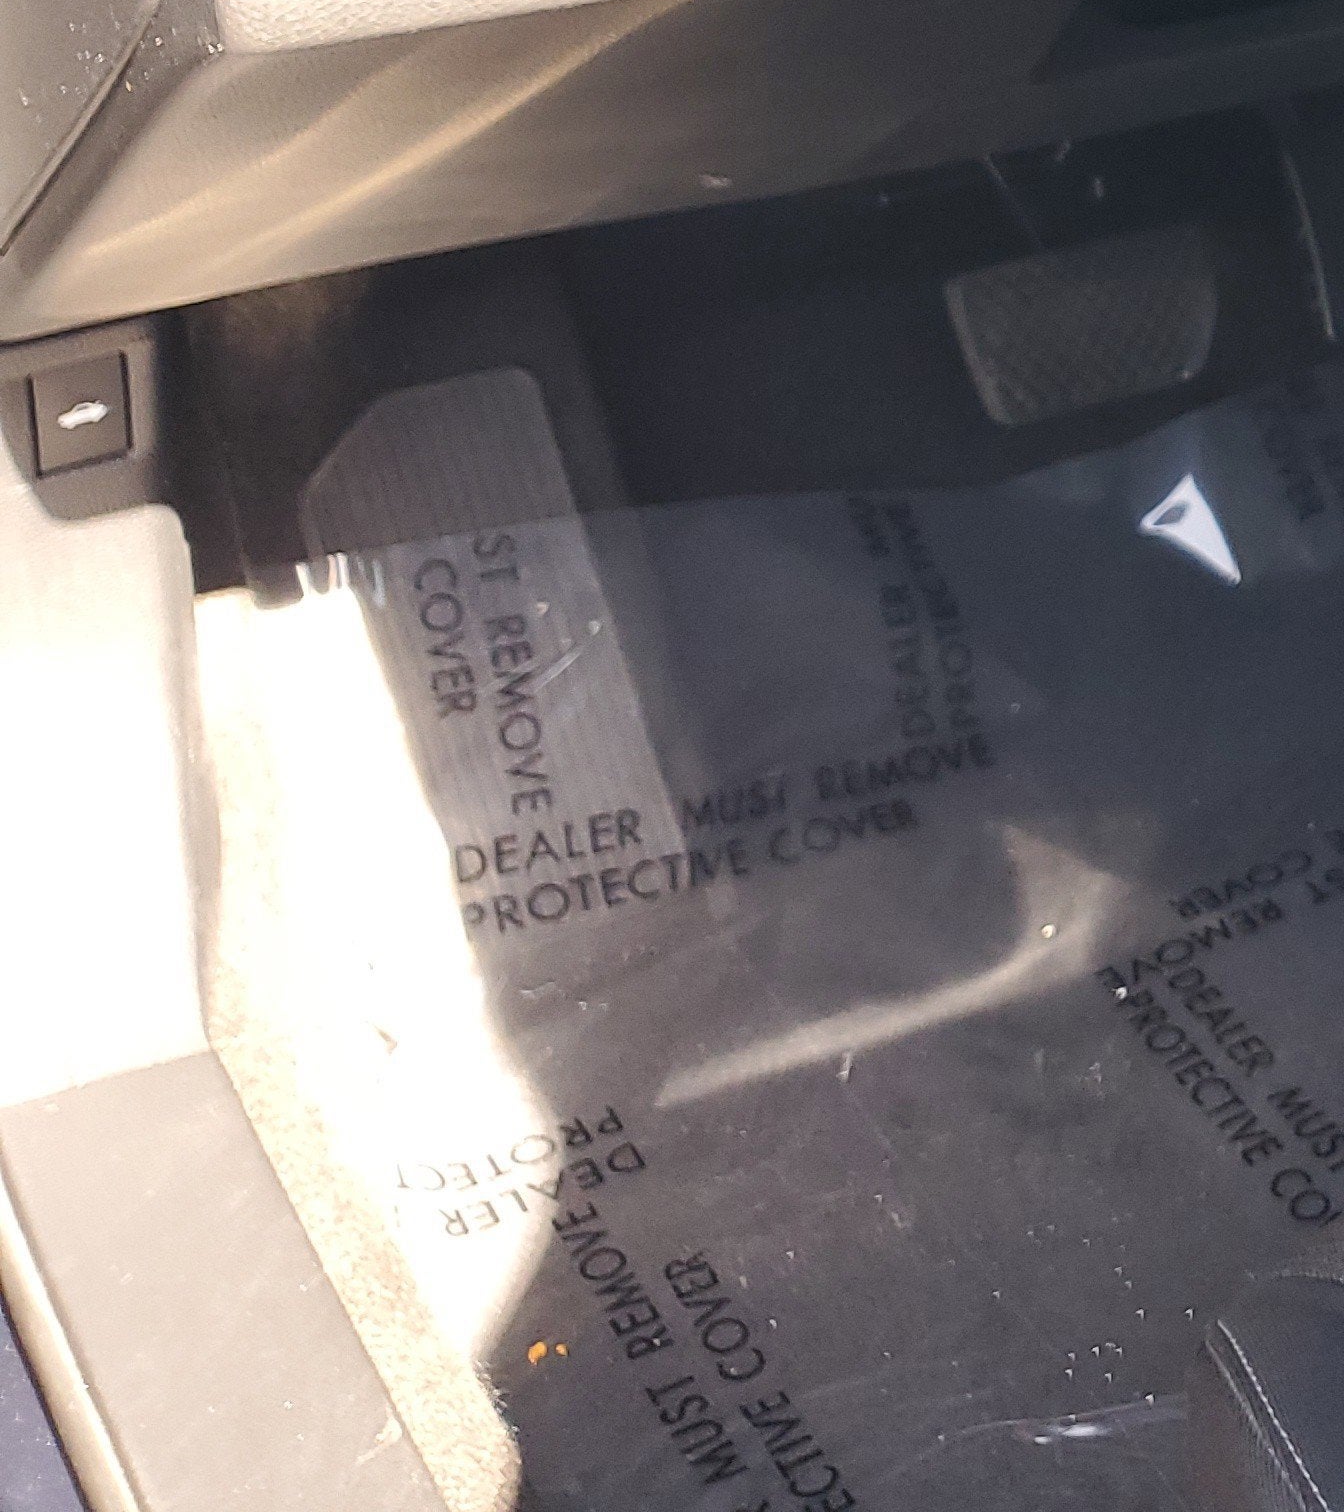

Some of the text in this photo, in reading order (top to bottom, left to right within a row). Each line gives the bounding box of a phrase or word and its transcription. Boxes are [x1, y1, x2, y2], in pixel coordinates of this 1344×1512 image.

[413, 558, 479, 720] COVER
[481, 614, 556, 816] REMOVE
[455, 733, 997, 884] DEALER MUST REMOVE
[463, 799, 920, 933] PROTECTIVE COVER
[1095, 898, 1285, 994] REMOVE
[1114, 988, 1285, 1169] PROTECTIVE
[1167, 966, 1276, 1079] DEALER
[437, 1140, 647, 1238] DEALER
[551, 1201, 748, 1485] MUST REMOVE
[664, 1249, 767, 1382] COVER
